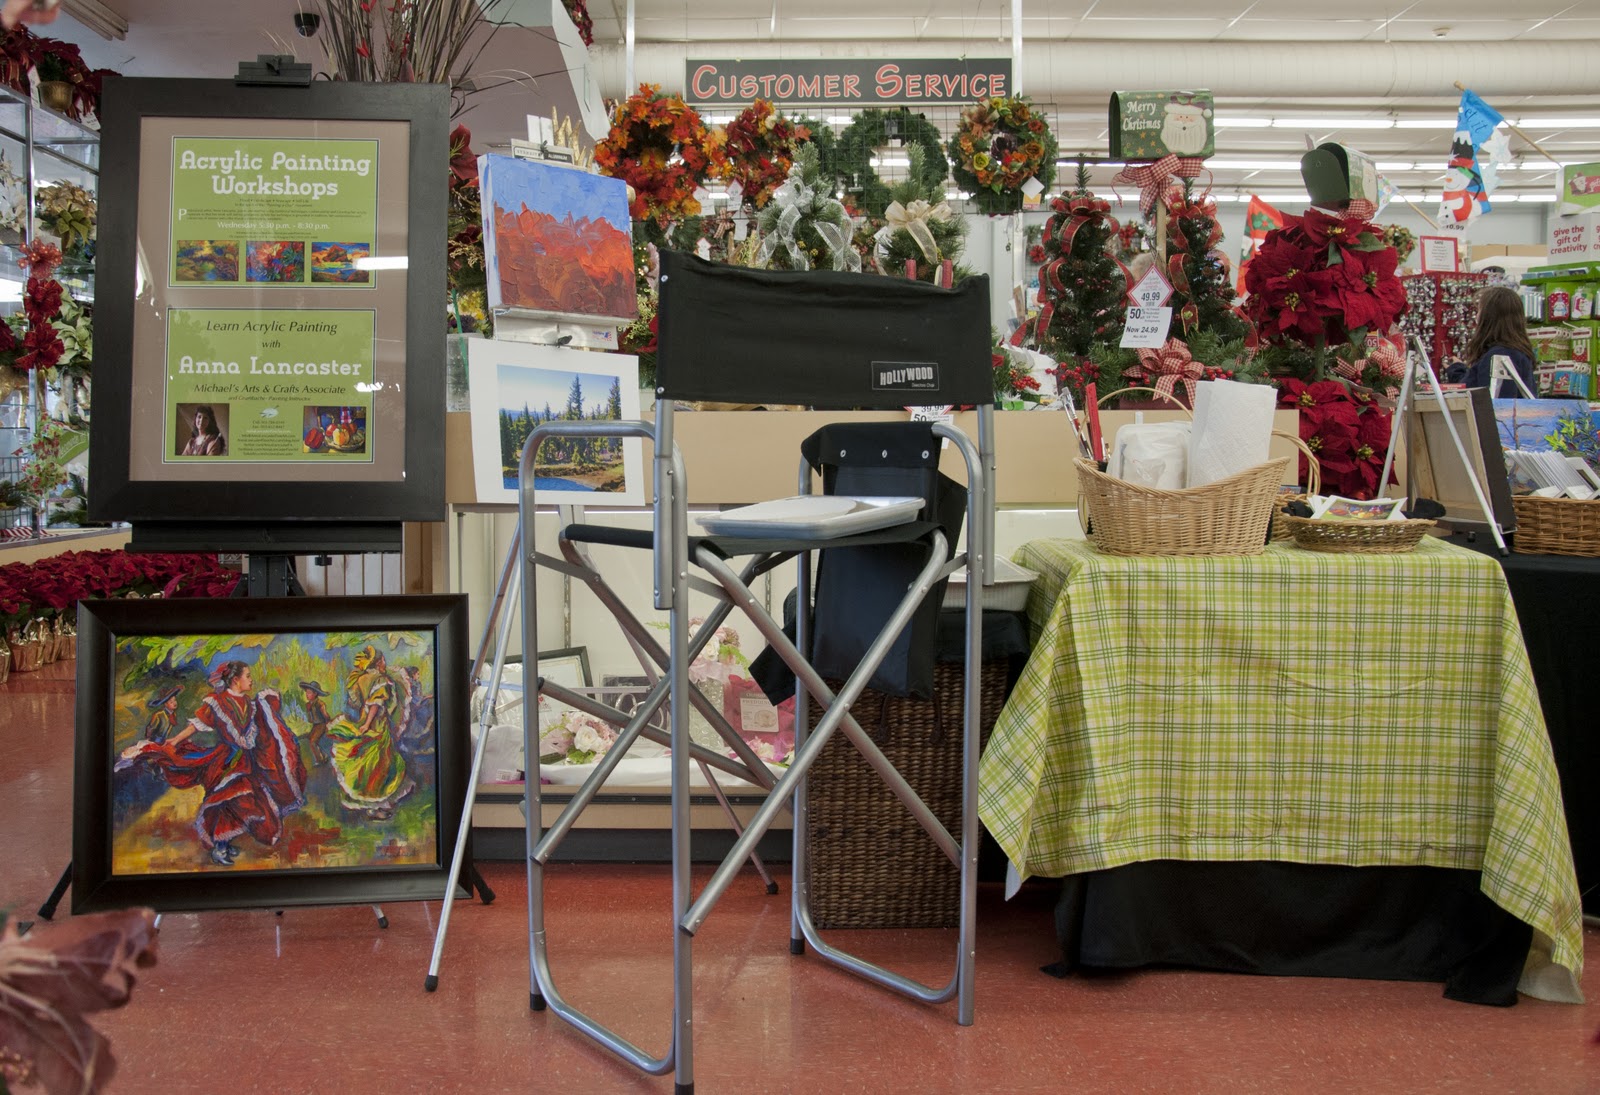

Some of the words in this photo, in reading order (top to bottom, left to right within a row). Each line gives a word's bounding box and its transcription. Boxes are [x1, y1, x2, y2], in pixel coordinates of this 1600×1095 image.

[1126, 101, 1156, 115] Merry
[1122, 117, 1161, 131] Christmas
[179, 150, 263, 174] Acrylic
[270, 151, 371, 176] Painting
[211, 175, 338, 200] Workshops
[217, 221, 257, 230] Wednesday
[314, 223, 330, 231] p.m.
[1553, 227, 1570, 238] give
[1571, 225, 1584, 233] the
[1556, 235, 1571, 247] gift
[1572, 234, 1582, 242] of
[1550, 243, 1588, 255] creativity
[1141, 291, 1161, 301] 49.99
[206, 320, 239, 331] Learn
[242, 320, 286, 335] Acrylic
[288, 321, 338, 335] Painting
[1141, 326, 1159, 334] 24.99
[261, 339, 281, 349] with
[178, 355, 241, 374] Anna
[249, 356, 362, 376] Lancaster
[880, 366, 933, 386] HOLLYWOOD
[193, 383, 239, 393] Michael's
[241, 384, 260, 393] Arts
[262, 384, 270, 393] &
[272, 384, 300, 394] Crafts
[301, 384, 346, 394] Associate
